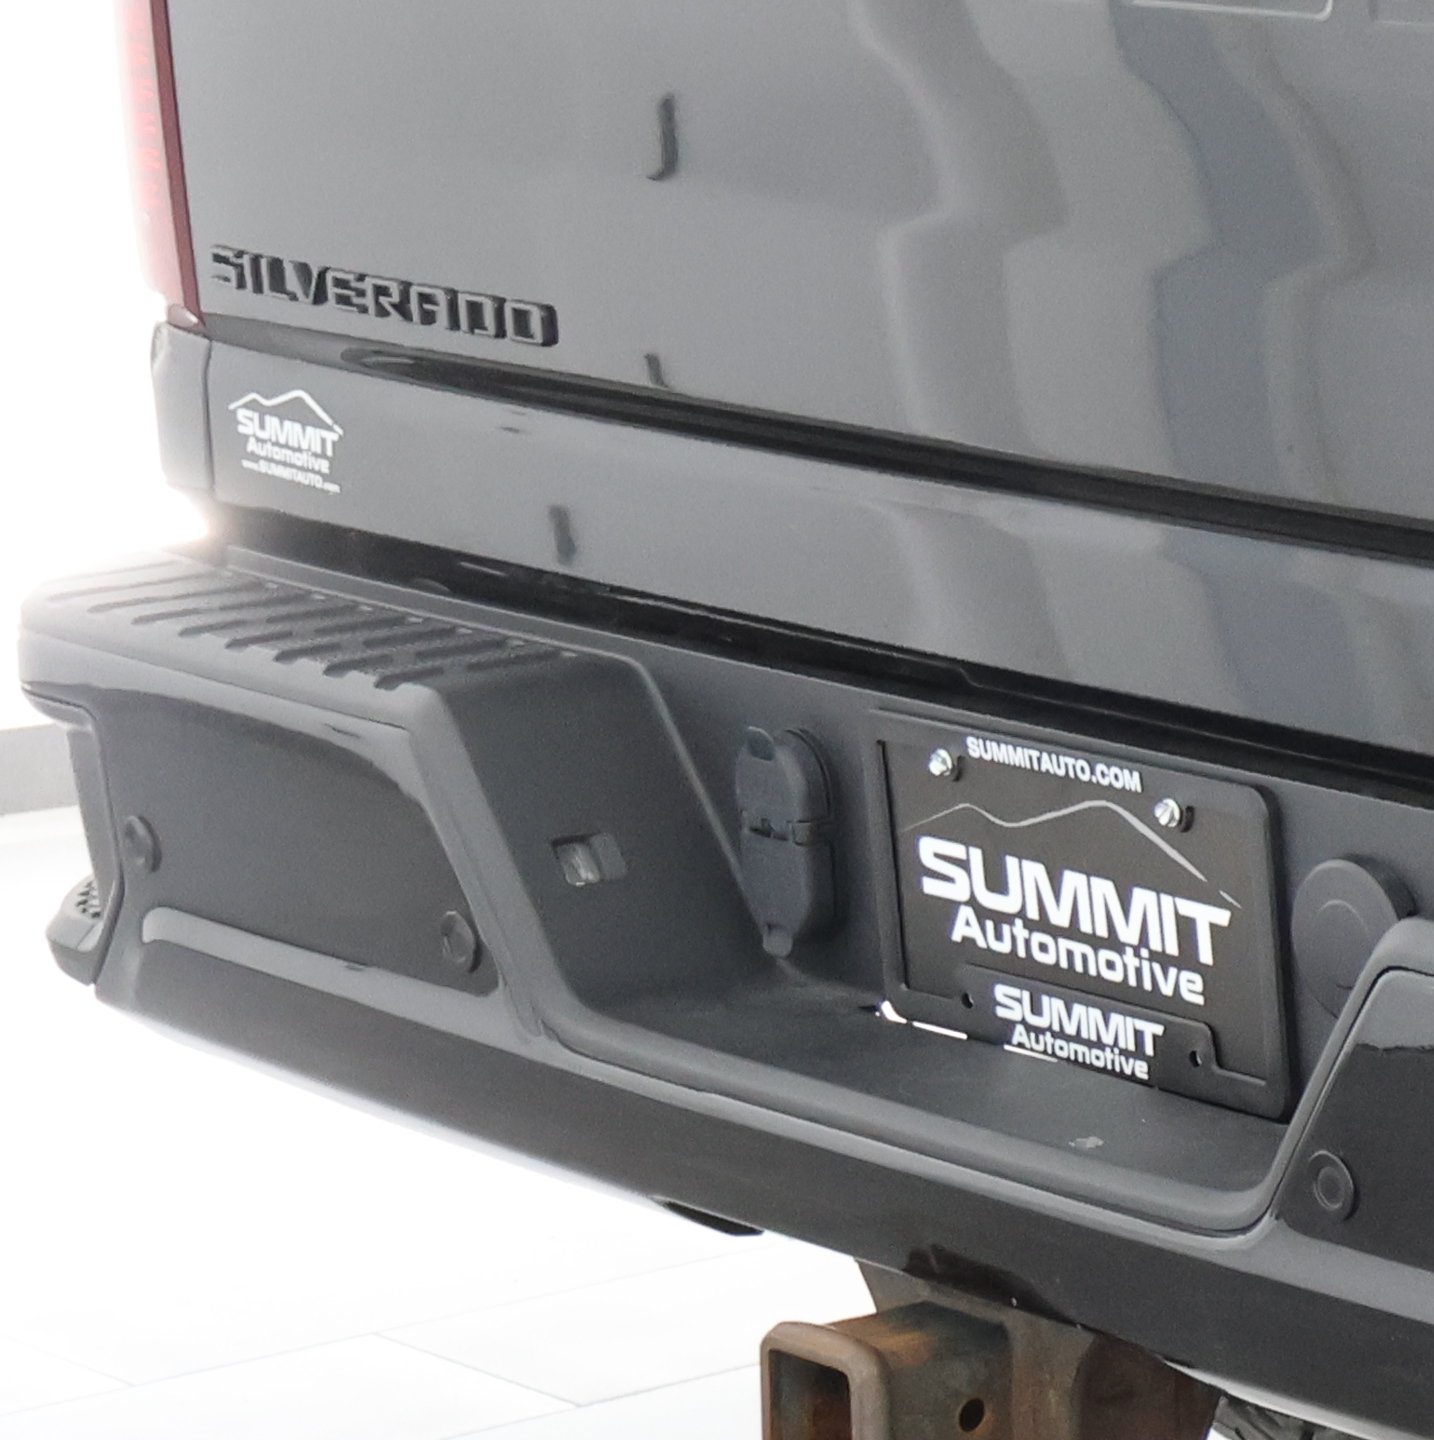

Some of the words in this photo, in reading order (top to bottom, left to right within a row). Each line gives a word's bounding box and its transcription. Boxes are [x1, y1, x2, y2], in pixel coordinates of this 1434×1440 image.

[210, 243, 560, 348] SILVERADO
[236, 407, 340, 458] SUMMIT
[246, 435, 330, 475] Automotive
[966, 735, 1143, 793] SUMMITAUTO.COM
[917, 834, 1232, 966] SUMMIT
[950, 904, 1206, 1005] Automotive
[993, 982, 1165, 1057] SUMMIT
[1010, 1023, 1150, 1080] Automotive
